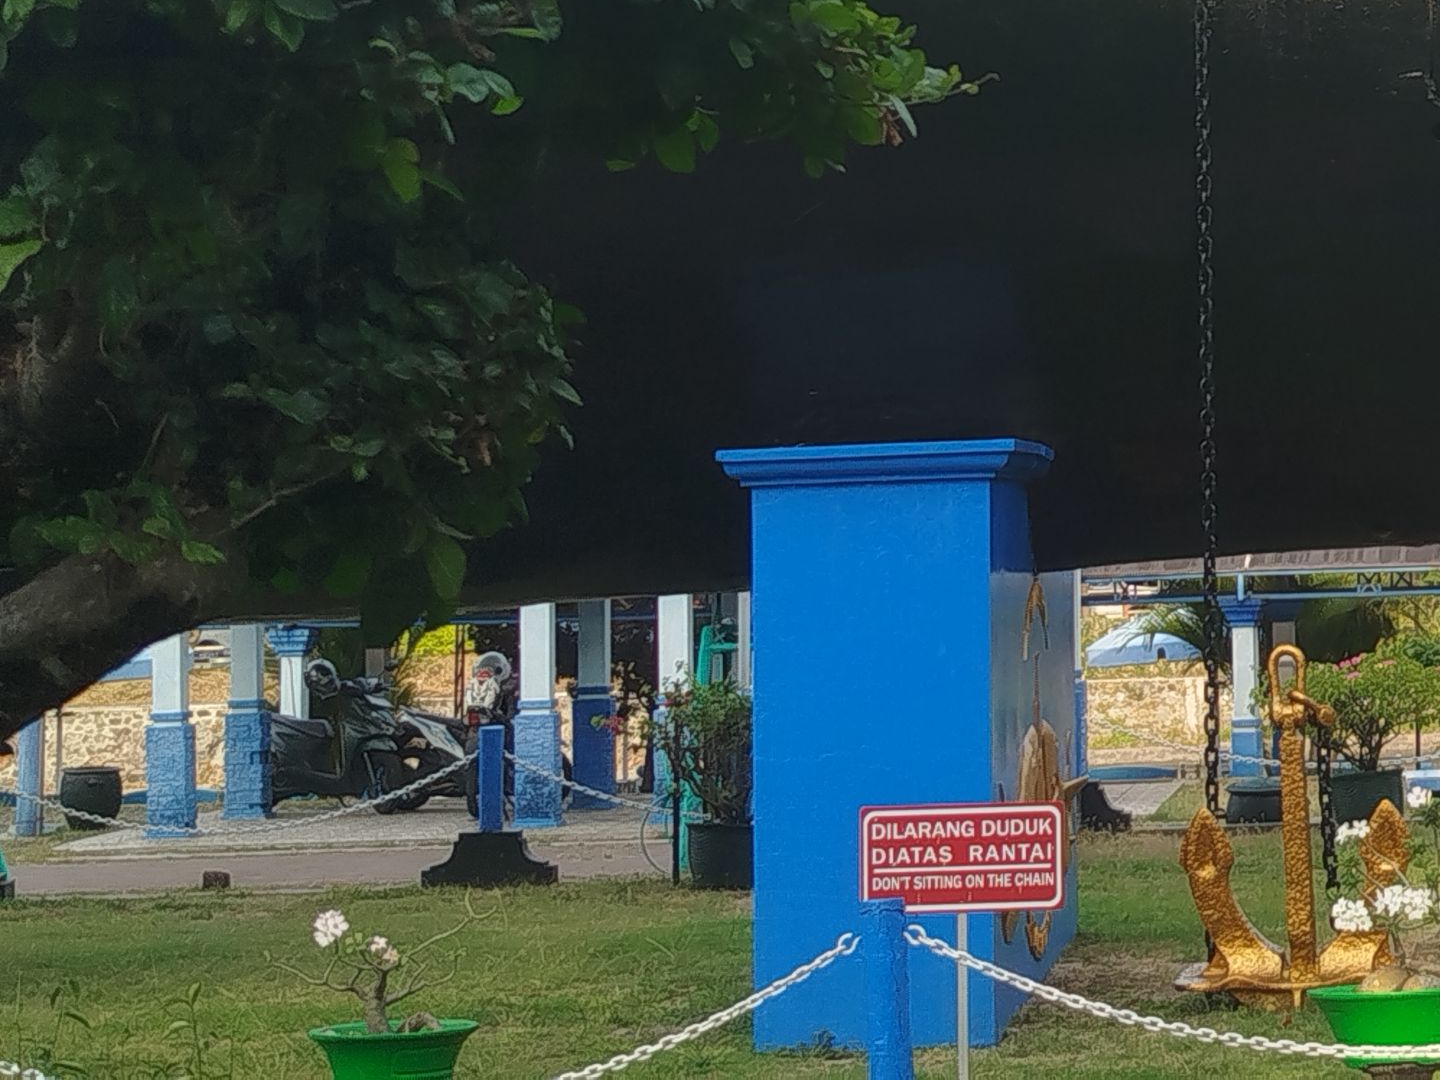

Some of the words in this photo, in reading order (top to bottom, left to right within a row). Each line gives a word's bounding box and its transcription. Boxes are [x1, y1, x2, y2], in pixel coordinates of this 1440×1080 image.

[871, 820, 975, 840] DILARANG
[981, 818, 1053, 836] DUDUK
[871, 845, 953, 865] DIATAS
[969, 842, 1052, 862] RANTAI
[872, 875, 911, 891] DON'T
[913, 873, 962, 890] SITTING
[965, 874, 983, 888] ON
[986, 872, 1012, 888] THE
[1014, 871, 1055, 887] CHAIN
